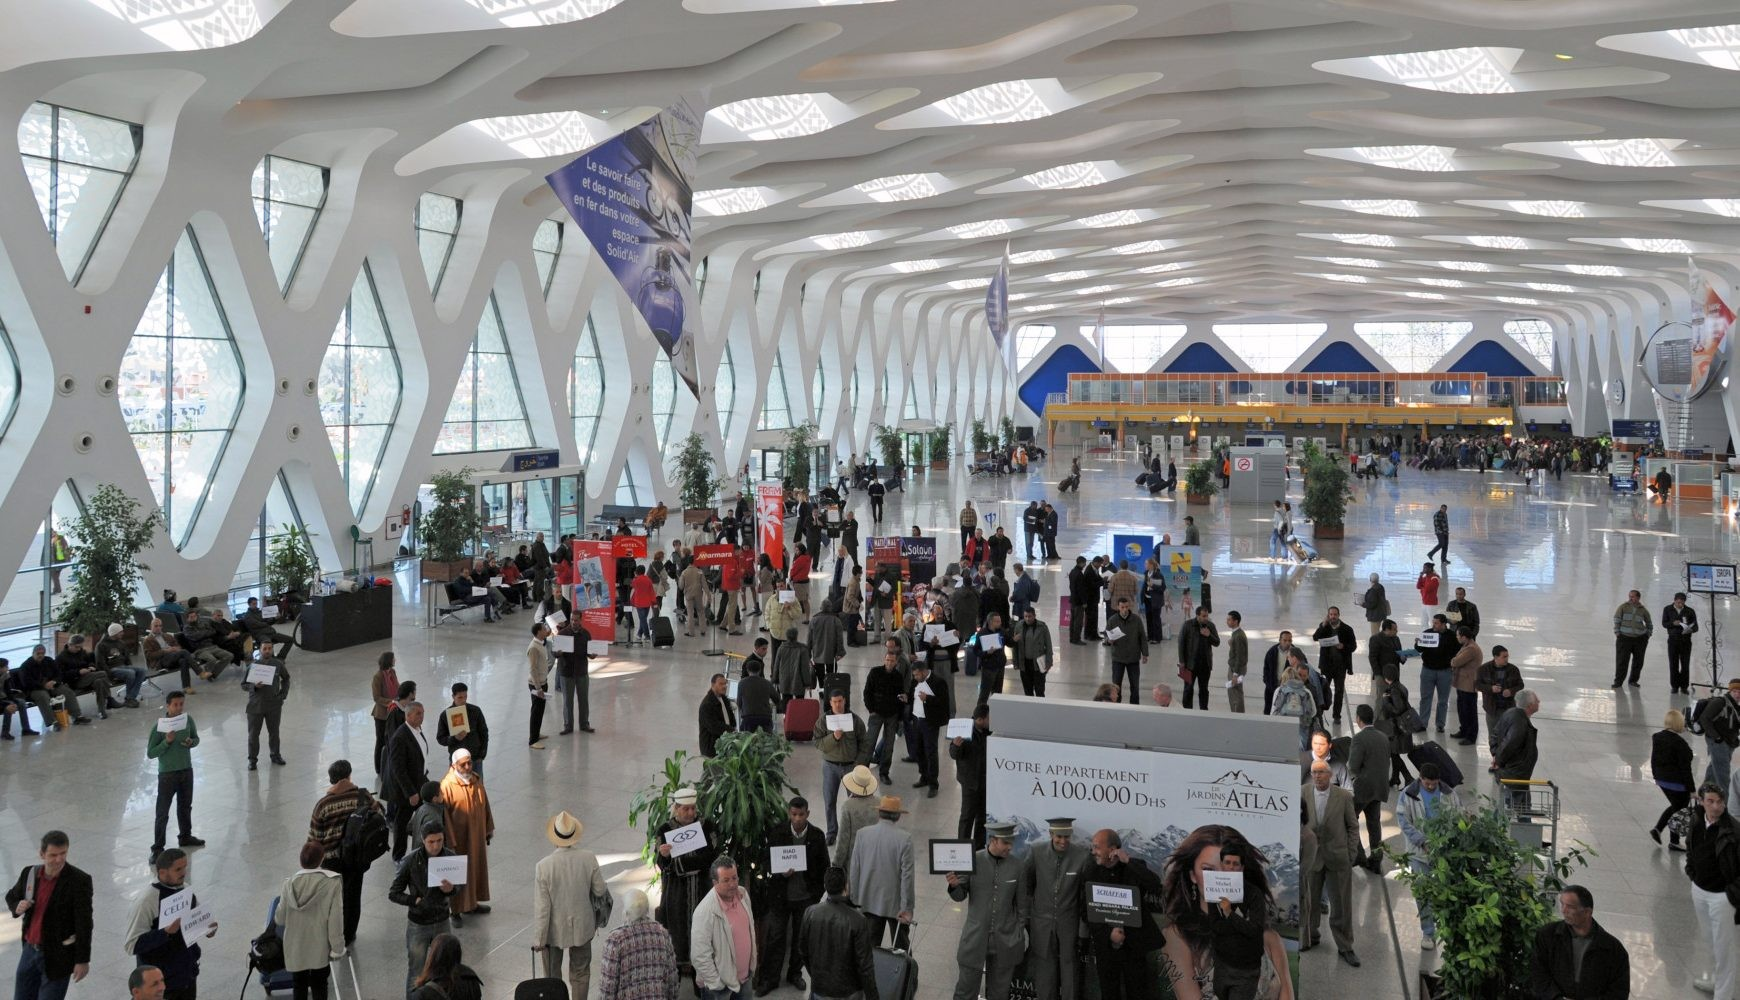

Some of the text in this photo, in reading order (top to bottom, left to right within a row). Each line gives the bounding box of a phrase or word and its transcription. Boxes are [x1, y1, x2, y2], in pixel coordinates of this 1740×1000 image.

[587, 156, 641, 191] Le savoir faire
[582, 177, 640, 209] et des produits
[574, 194, 640, 228] en fer dans votre
[612, 228, 640, 245] espace
[607, 243, 640, 264] Solid'Air
[758, 486, 782, 495] FRAM
[696, 551, 733, 560] Marmara
[994, 757, 1149, 784] VOTRE APPARTEMENT
[1031, 777, 1045, 797] À
[1051, 780, 1131, 805] 100.000
[1187, 788, 1226, 801] JARDINS
[1225, 788, 1289, 812] ATLAS
